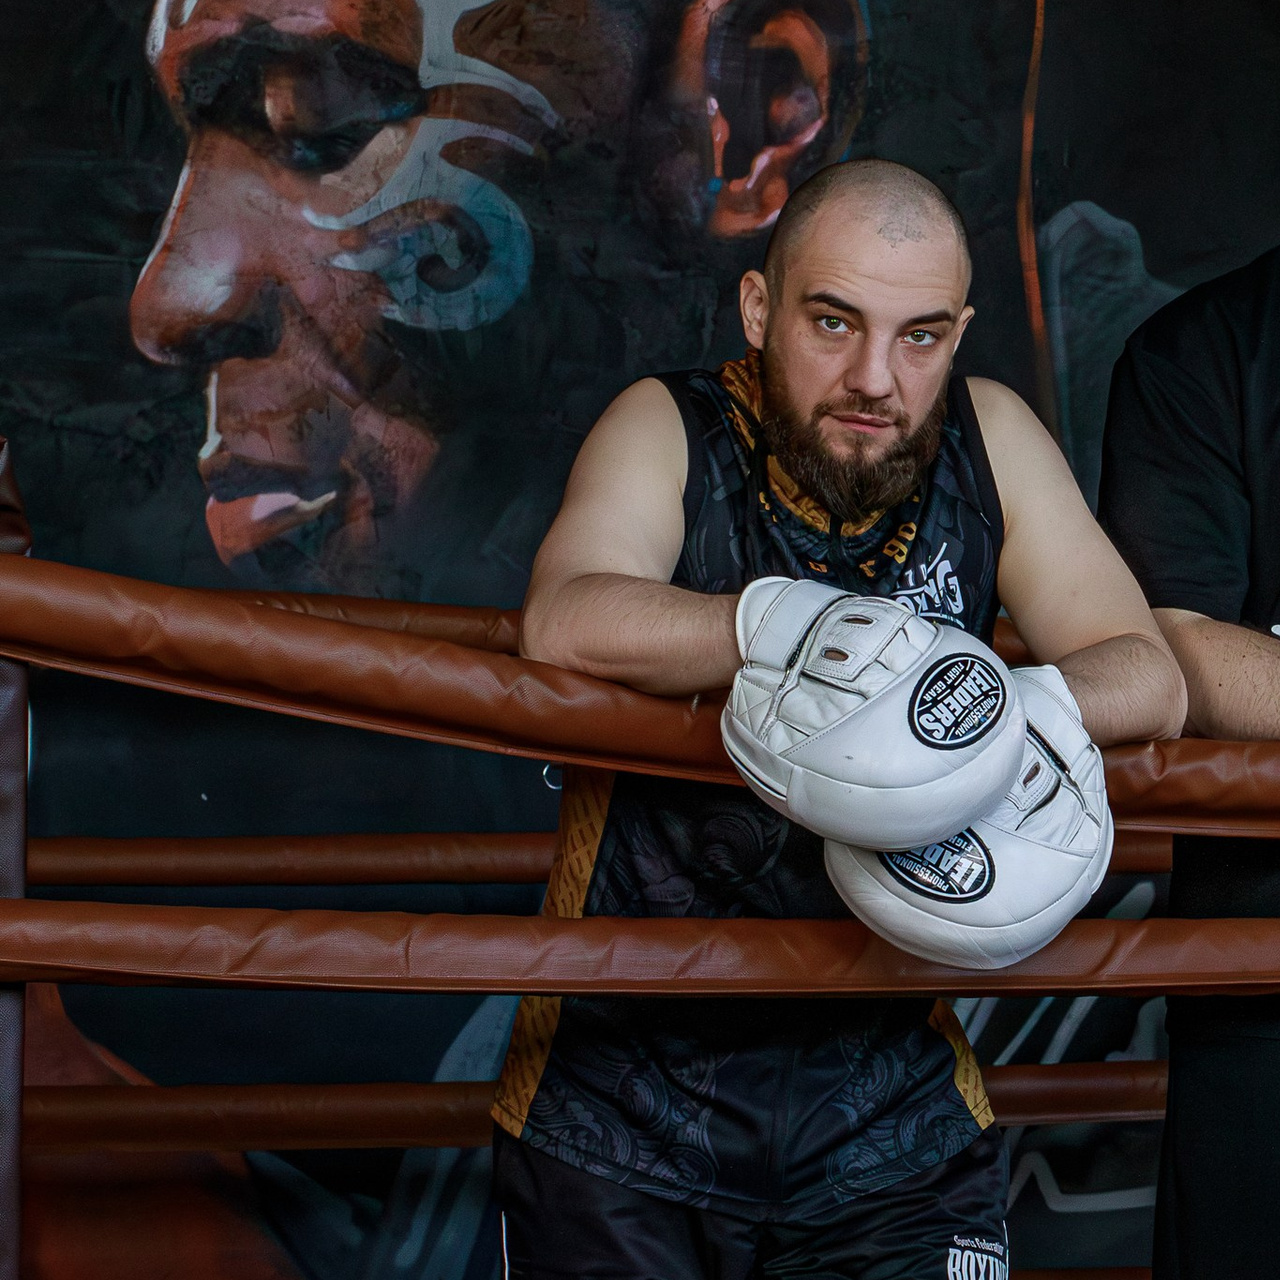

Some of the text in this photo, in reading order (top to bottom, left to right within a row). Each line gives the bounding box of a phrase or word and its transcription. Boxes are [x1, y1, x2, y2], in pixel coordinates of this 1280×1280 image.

[918, 662, 998, 740] LEADERS
[923, 662, 965, 702] FIGHT GEAR
[955, 695, 997, 737] PROFESSIONAL
[948, 835, 974, 853] FIGH
[891, 853, 950, 892] PROFESSIONAL
[910, 842, 984, 893] LEAD
